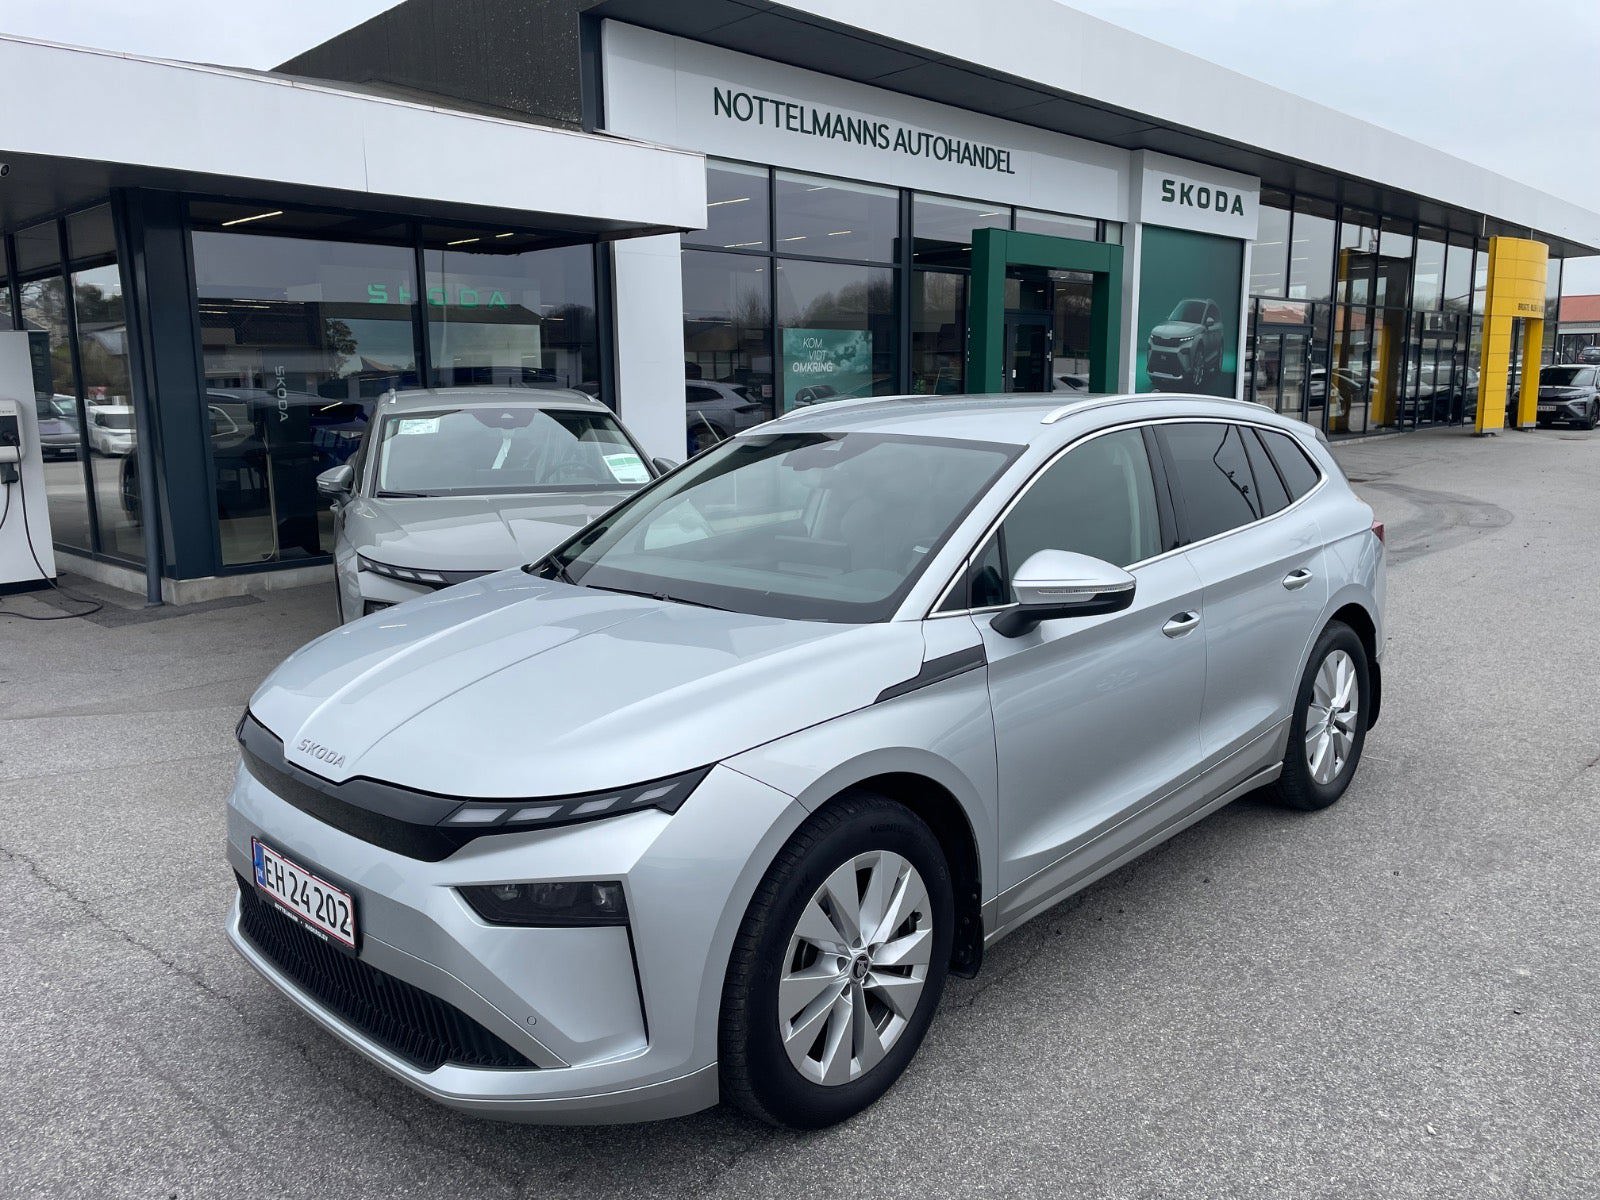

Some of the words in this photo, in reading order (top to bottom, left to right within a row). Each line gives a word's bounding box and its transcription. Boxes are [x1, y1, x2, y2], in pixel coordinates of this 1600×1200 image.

[713, 86, 890, 150] NOTTELMANNS
[892, 127, 1016, 174] AUTOHANDEL
[1161, 179, 1245, 217] SKODA
[802, 337, 823, 349] KOM
[792, 361, 833, 373] OMKRING
[274, 365, 289, 422] SKODA
[296, 738, 346, 768] SKODA
[264, 854, 286, 898] EH
[288, 870, 311, 914] 24
[313, 886, 352, 938] 202
